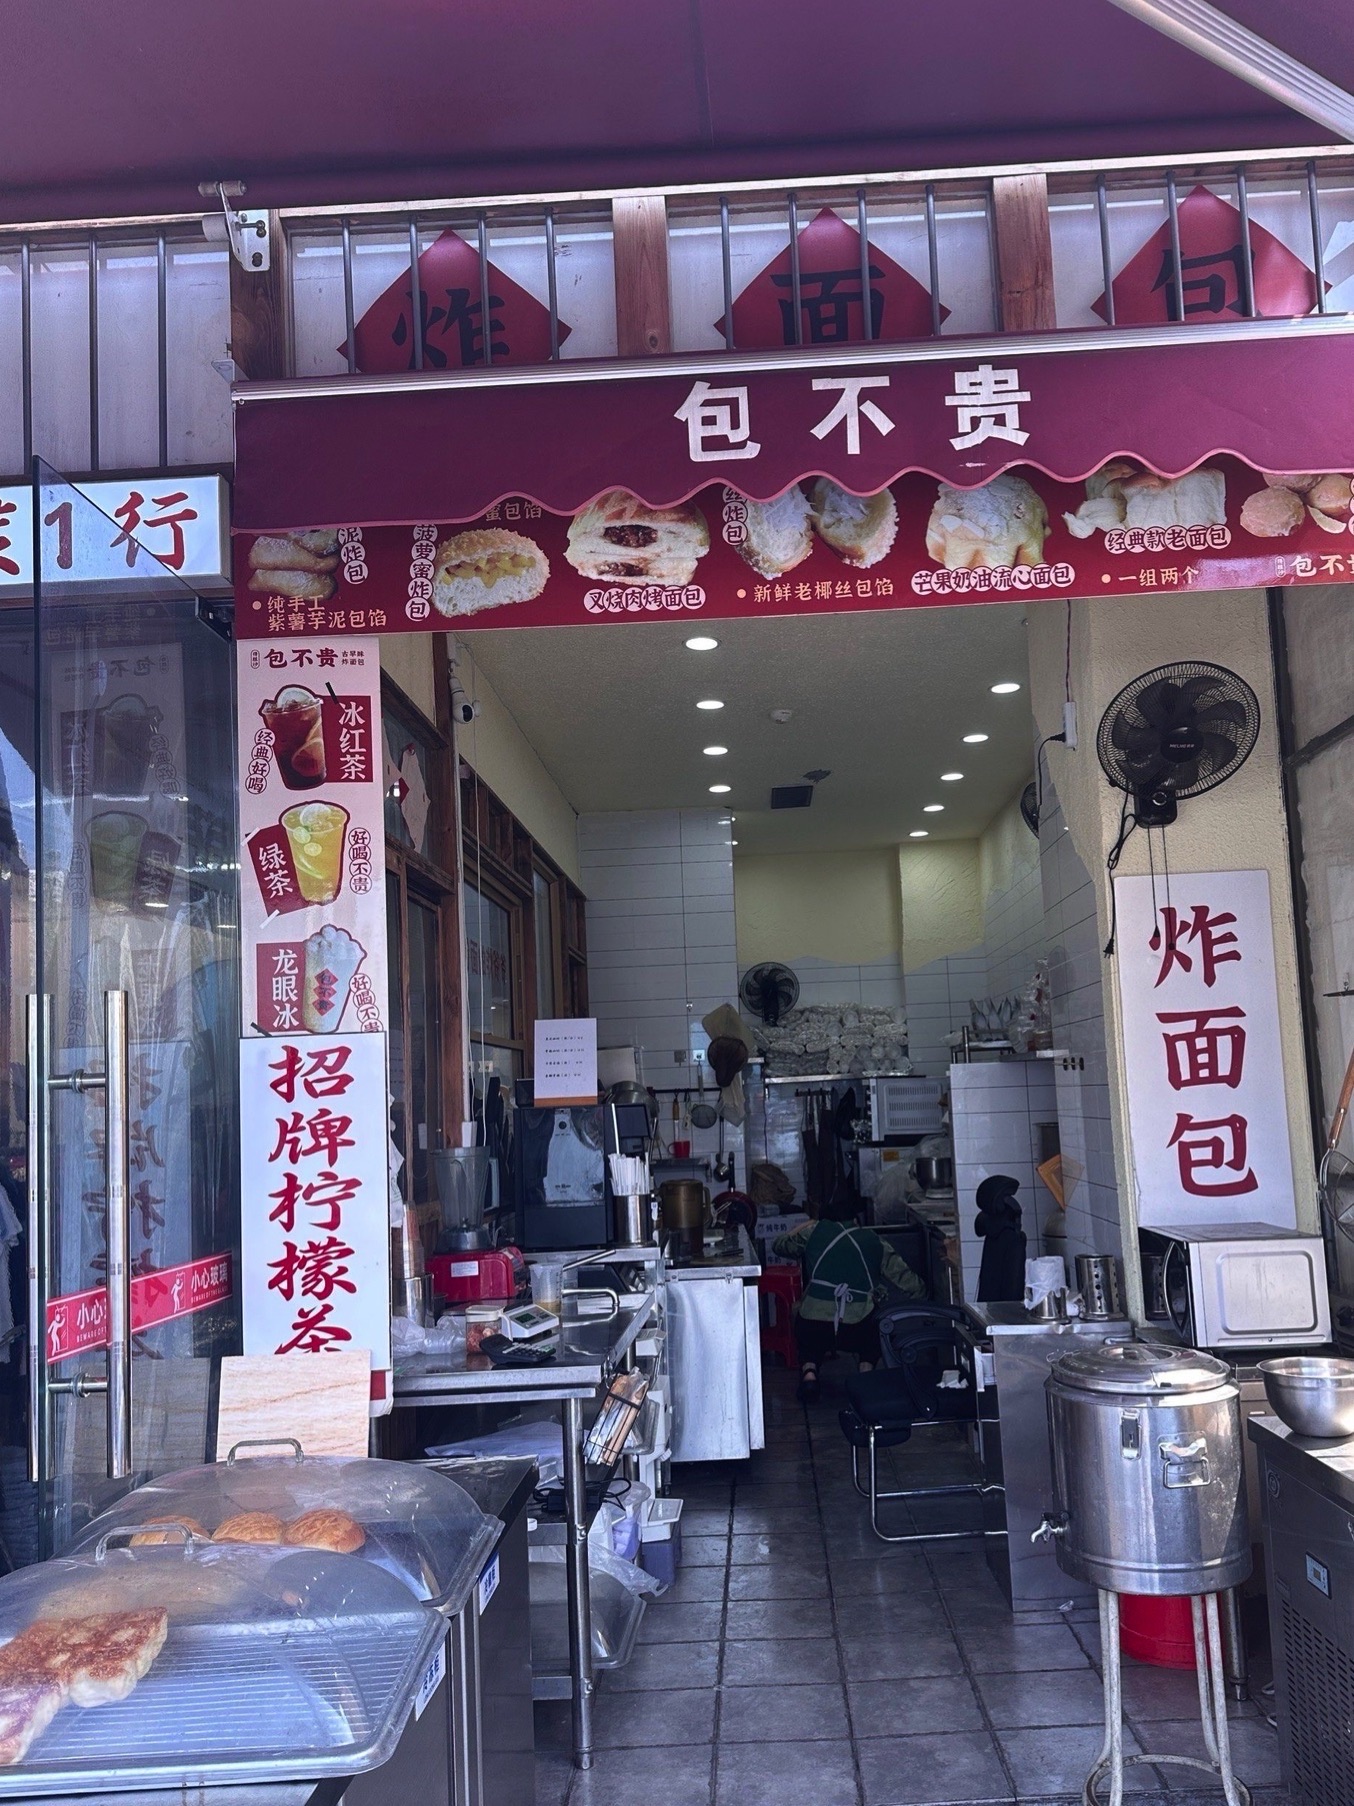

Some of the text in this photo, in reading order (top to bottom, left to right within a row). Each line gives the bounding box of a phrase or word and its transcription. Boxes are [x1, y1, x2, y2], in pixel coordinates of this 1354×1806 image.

[770, 265, 886, 345] 面
[392, 288, 510, 369] 炸
[674, 364, 1031, 463] 包不贵
[1107, 527, 1228, 553] 经典款老面包
[408, 524, 434, 619] 菠萝蜜炸包
[914, 565, 1072, 594] 芒果奶油流心面包
[1118, 566, 1199, 587] 一组两个
[1290, 554, 1354, 577] 包不
[267, 596, 324, 613] 纯手工
[587, 588, 702, 609] 叉烧肉烤面包
[753, 579, 894, 603] 新鲜老椰丝包馅
[267, 609, 387, 631] 紫薯芋泥包馅
[264, 648, 338, 668] 包不贵
[249, 730, 273, 793] 经典好喝
[338, 702, 366, 780] 冰红茶
[258, 843, 293, 898] 绿茶
[350, 829, 370, 893] 好喝不贵
[272, 949, 300, 1032] 龙眼冰
[1148, 905, 1259, 1197] 炸面包
[267, 1045, 362, 1355] 招牌柠檬茶
[191, 1262, 228, 1293] 小心玻璃
[77, 1298, 106, 1329] 小心
